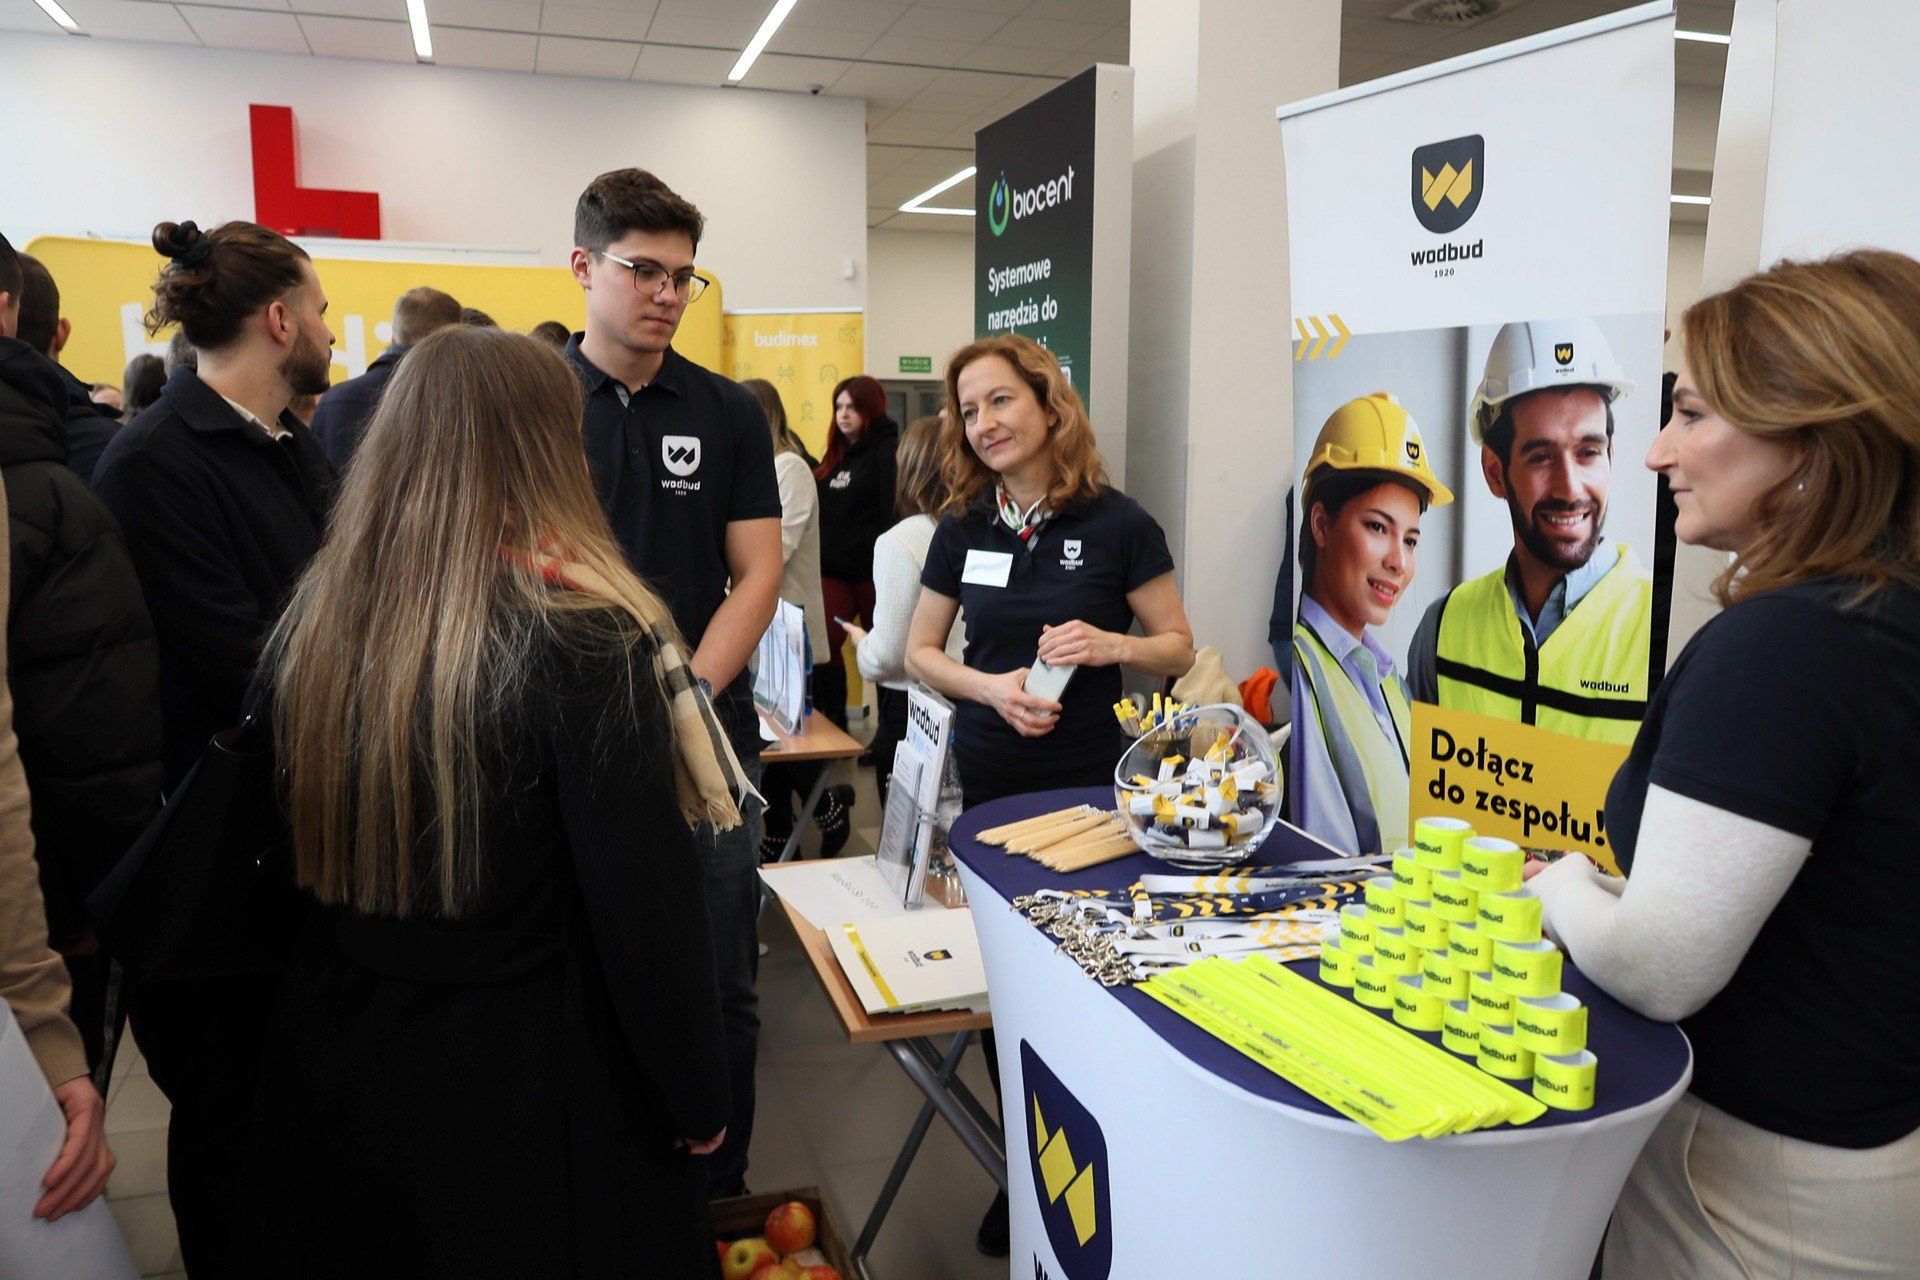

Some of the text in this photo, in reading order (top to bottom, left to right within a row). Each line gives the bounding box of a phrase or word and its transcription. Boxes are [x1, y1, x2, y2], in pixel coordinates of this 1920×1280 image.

[1013, 164, 1075, 220] biocent
[1410, 238, 1483, 267] wodbud
[988, 258, 1051, 297] Systemowe
[1434, 268, 1455, 278] 1920
[988, 293, 1058, 334] narzędzia do
[754, 330, 819, 348] budimex
[661, 479, 701, 491] wodbud
[1580, 679, 1629, 693] wodbud
[909, 699, 941, 747] wodbud
[1431, 727, 1535, 786] Dołącz
[1428, 768, 1607, 847] do zespołu!
